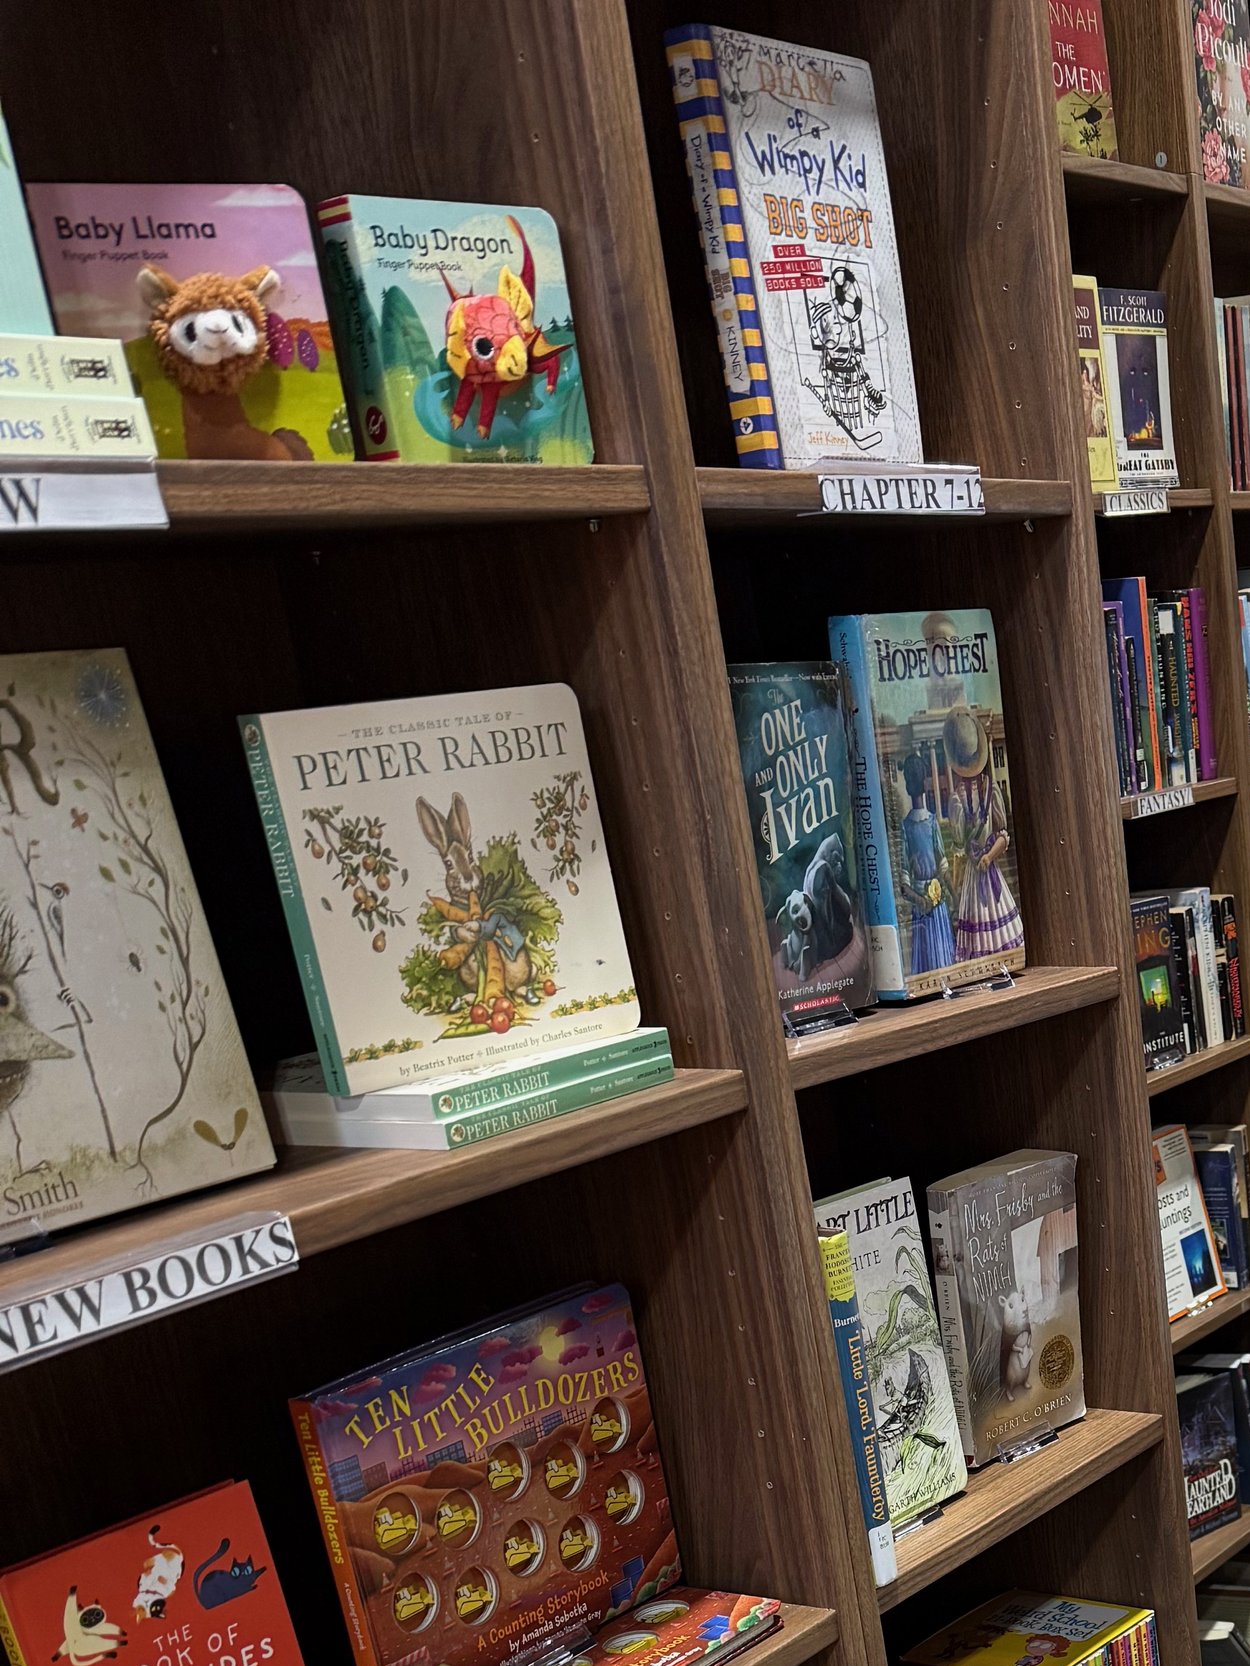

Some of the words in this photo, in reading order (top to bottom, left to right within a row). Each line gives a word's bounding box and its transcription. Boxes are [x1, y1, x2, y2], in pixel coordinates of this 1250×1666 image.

[1197, 22, 1250, 70] Picoult
[756, 61, 836, 106] DIARY
[788, 109, 802, 129] of
[812, 125, 820, 139] a
[745, 132, 825, 195] Wimpy
[832, 140, 866, 192] Kid
[55, 217, 123, 247] Baby
[135, 217, 216, 240] Llama
[370, 225, 429, 257] Baby
[434, 230, 513, 261] Dragon
[764, 194, 805, 238] BIG
[815, 203, 872, 248] SHOT
[763, 262, 782, 273] 250
[786, 261, 821, 272] MILLION
[777, 246, 801, 257] OVER
[767, 278, 796, 289] BOOKS
[800, 276, 824, 288] SOLD
[1104, 306, 1164, 324] FITZGERALD
[820, 477, 937, 511] CHAPTER
[943, 478, 983, 510] 7-12
[1109, 494, 1164, 512] CLASSICS
[876, 639, 928, 682] HOPE
[932, 633, 988, 675] CHEST
[352, 726, 388, 739] THE
[392, 718, 450, 736] CLASSIC
[457, 714, 489, 729] TALE
[495, 711, 512, 724] OF
[761, 699, 805, 756] ONE
[294, 733, 426, 791] PETER
[442, 721, 567, 771] RABBIT
[755, 768, 773, 787] AND
[776, 734, 829, 797] ONLY
[765, 778, 838, 865] Ivan
[778, 984, 815, 1000] Katherine
[816, 976, 854, 994] Applegate
[964, 1200, 991, 1238] Mrs.
[995, 1190, 1034, 1225] Frisby
[0, 1276, 107, 1359] NEW
[122, 1220, 297, 1318] BOOKS
[344, 1385, 413, 1449] TEN
[392, 1362, 495, 1460] LITTLE
[462, 1351, 639, 1452] BULLDOZERS
[986, 1417, 1020, 1441] ROBERT
[1033, 1394, 1071, 1419] O'BRIEN
[152, 1624, 193, 1651] THE
[207, 1622, 240, 1652] OF
